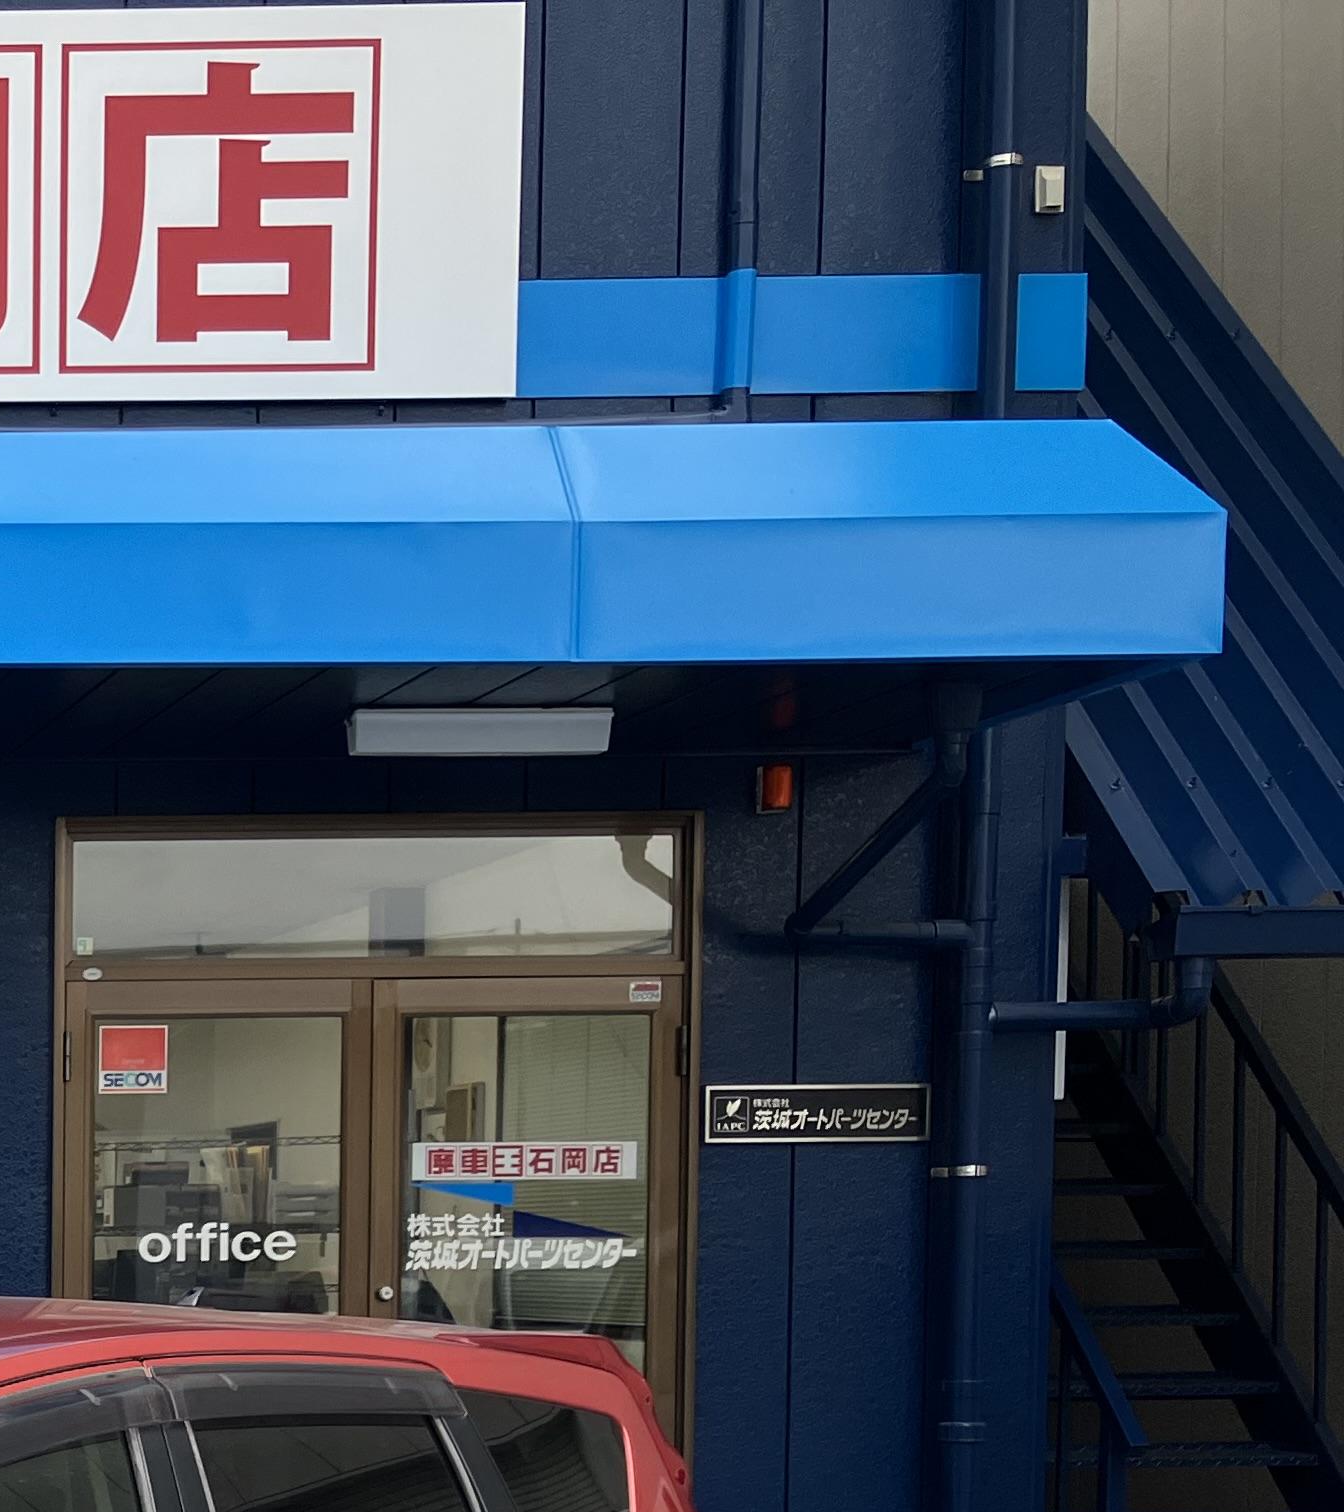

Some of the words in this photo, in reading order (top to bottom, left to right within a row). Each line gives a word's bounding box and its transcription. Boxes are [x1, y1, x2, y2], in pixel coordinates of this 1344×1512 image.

[103, 1072, 163, 1088] SECOM
[716, 1121, 746, 1131] IAPC
[752, 1108, 918, 1131] 茨城オートパーツセンター
[426, 1145, 621, 1177] 廃車王石岡店
[406, 1213, 505, 1238] 株式会社
[138, 1222, 297, 1263] office
[405, 1238, 638, 1271] 茨城オートパーツセンター
